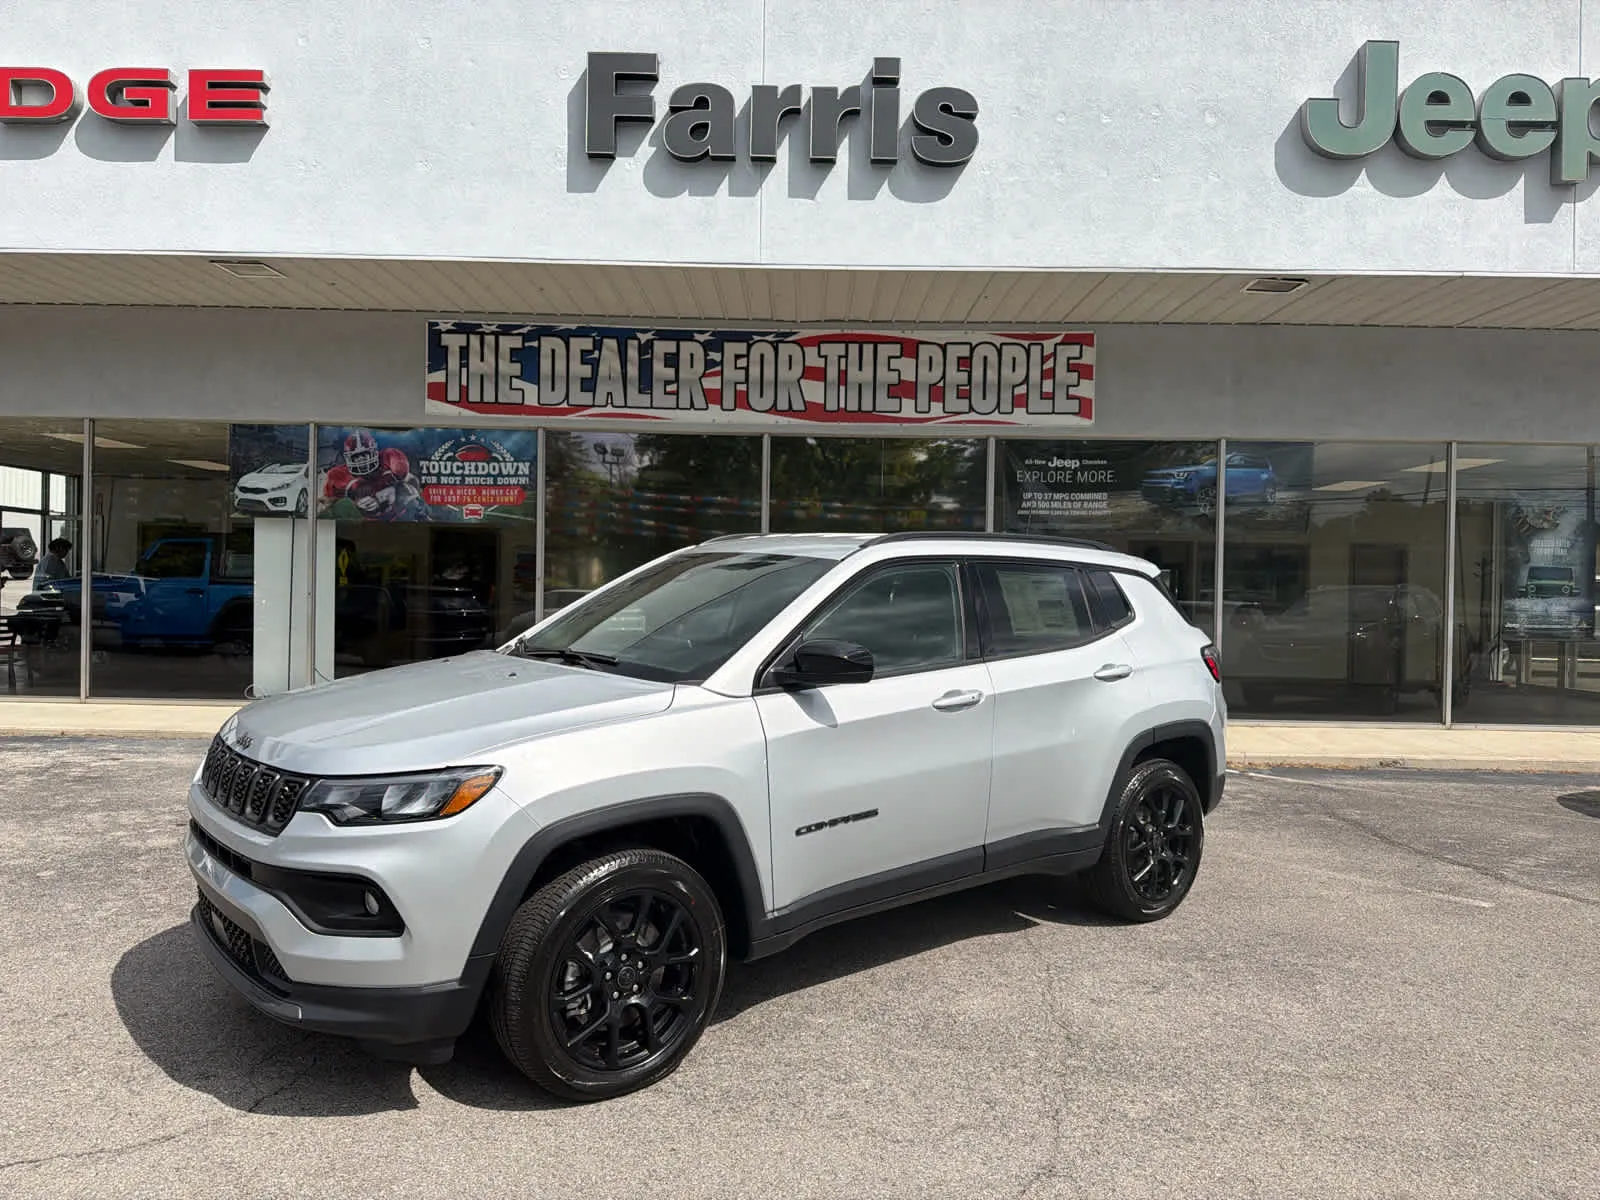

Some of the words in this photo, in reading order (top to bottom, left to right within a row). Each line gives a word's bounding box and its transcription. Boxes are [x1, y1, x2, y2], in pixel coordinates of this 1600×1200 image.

[0, 67, 270, 126] DGE
[585, 51, 980, 167] Farris
[440, 333, 525, 405] THE
[537, 335, 709, 410] DEALER
[720, 339, 806, 413] FOR
[817, 341, 902, 414] THE
[914, 341, 1083, 415] PEOPLE
[419, 460, 530, 475] TOUCHDOWN
[1047, 456, 1080, 469] Jeep
[421, 475, 438, 484] FOR
[440, 476, 462, 485] NOT
[464, 477, 494, 485] MUCH
[496, 477, 529, 485] DOWN!
[1016, 470, 1073, 483] EXPLORE
[1022, 492, 1033, 500] UP
[1033, 492, 1043, 500] TO
[1070, 492, 1108, 500] COMBINED
[1083, 501, 1109, 509] RANGE
